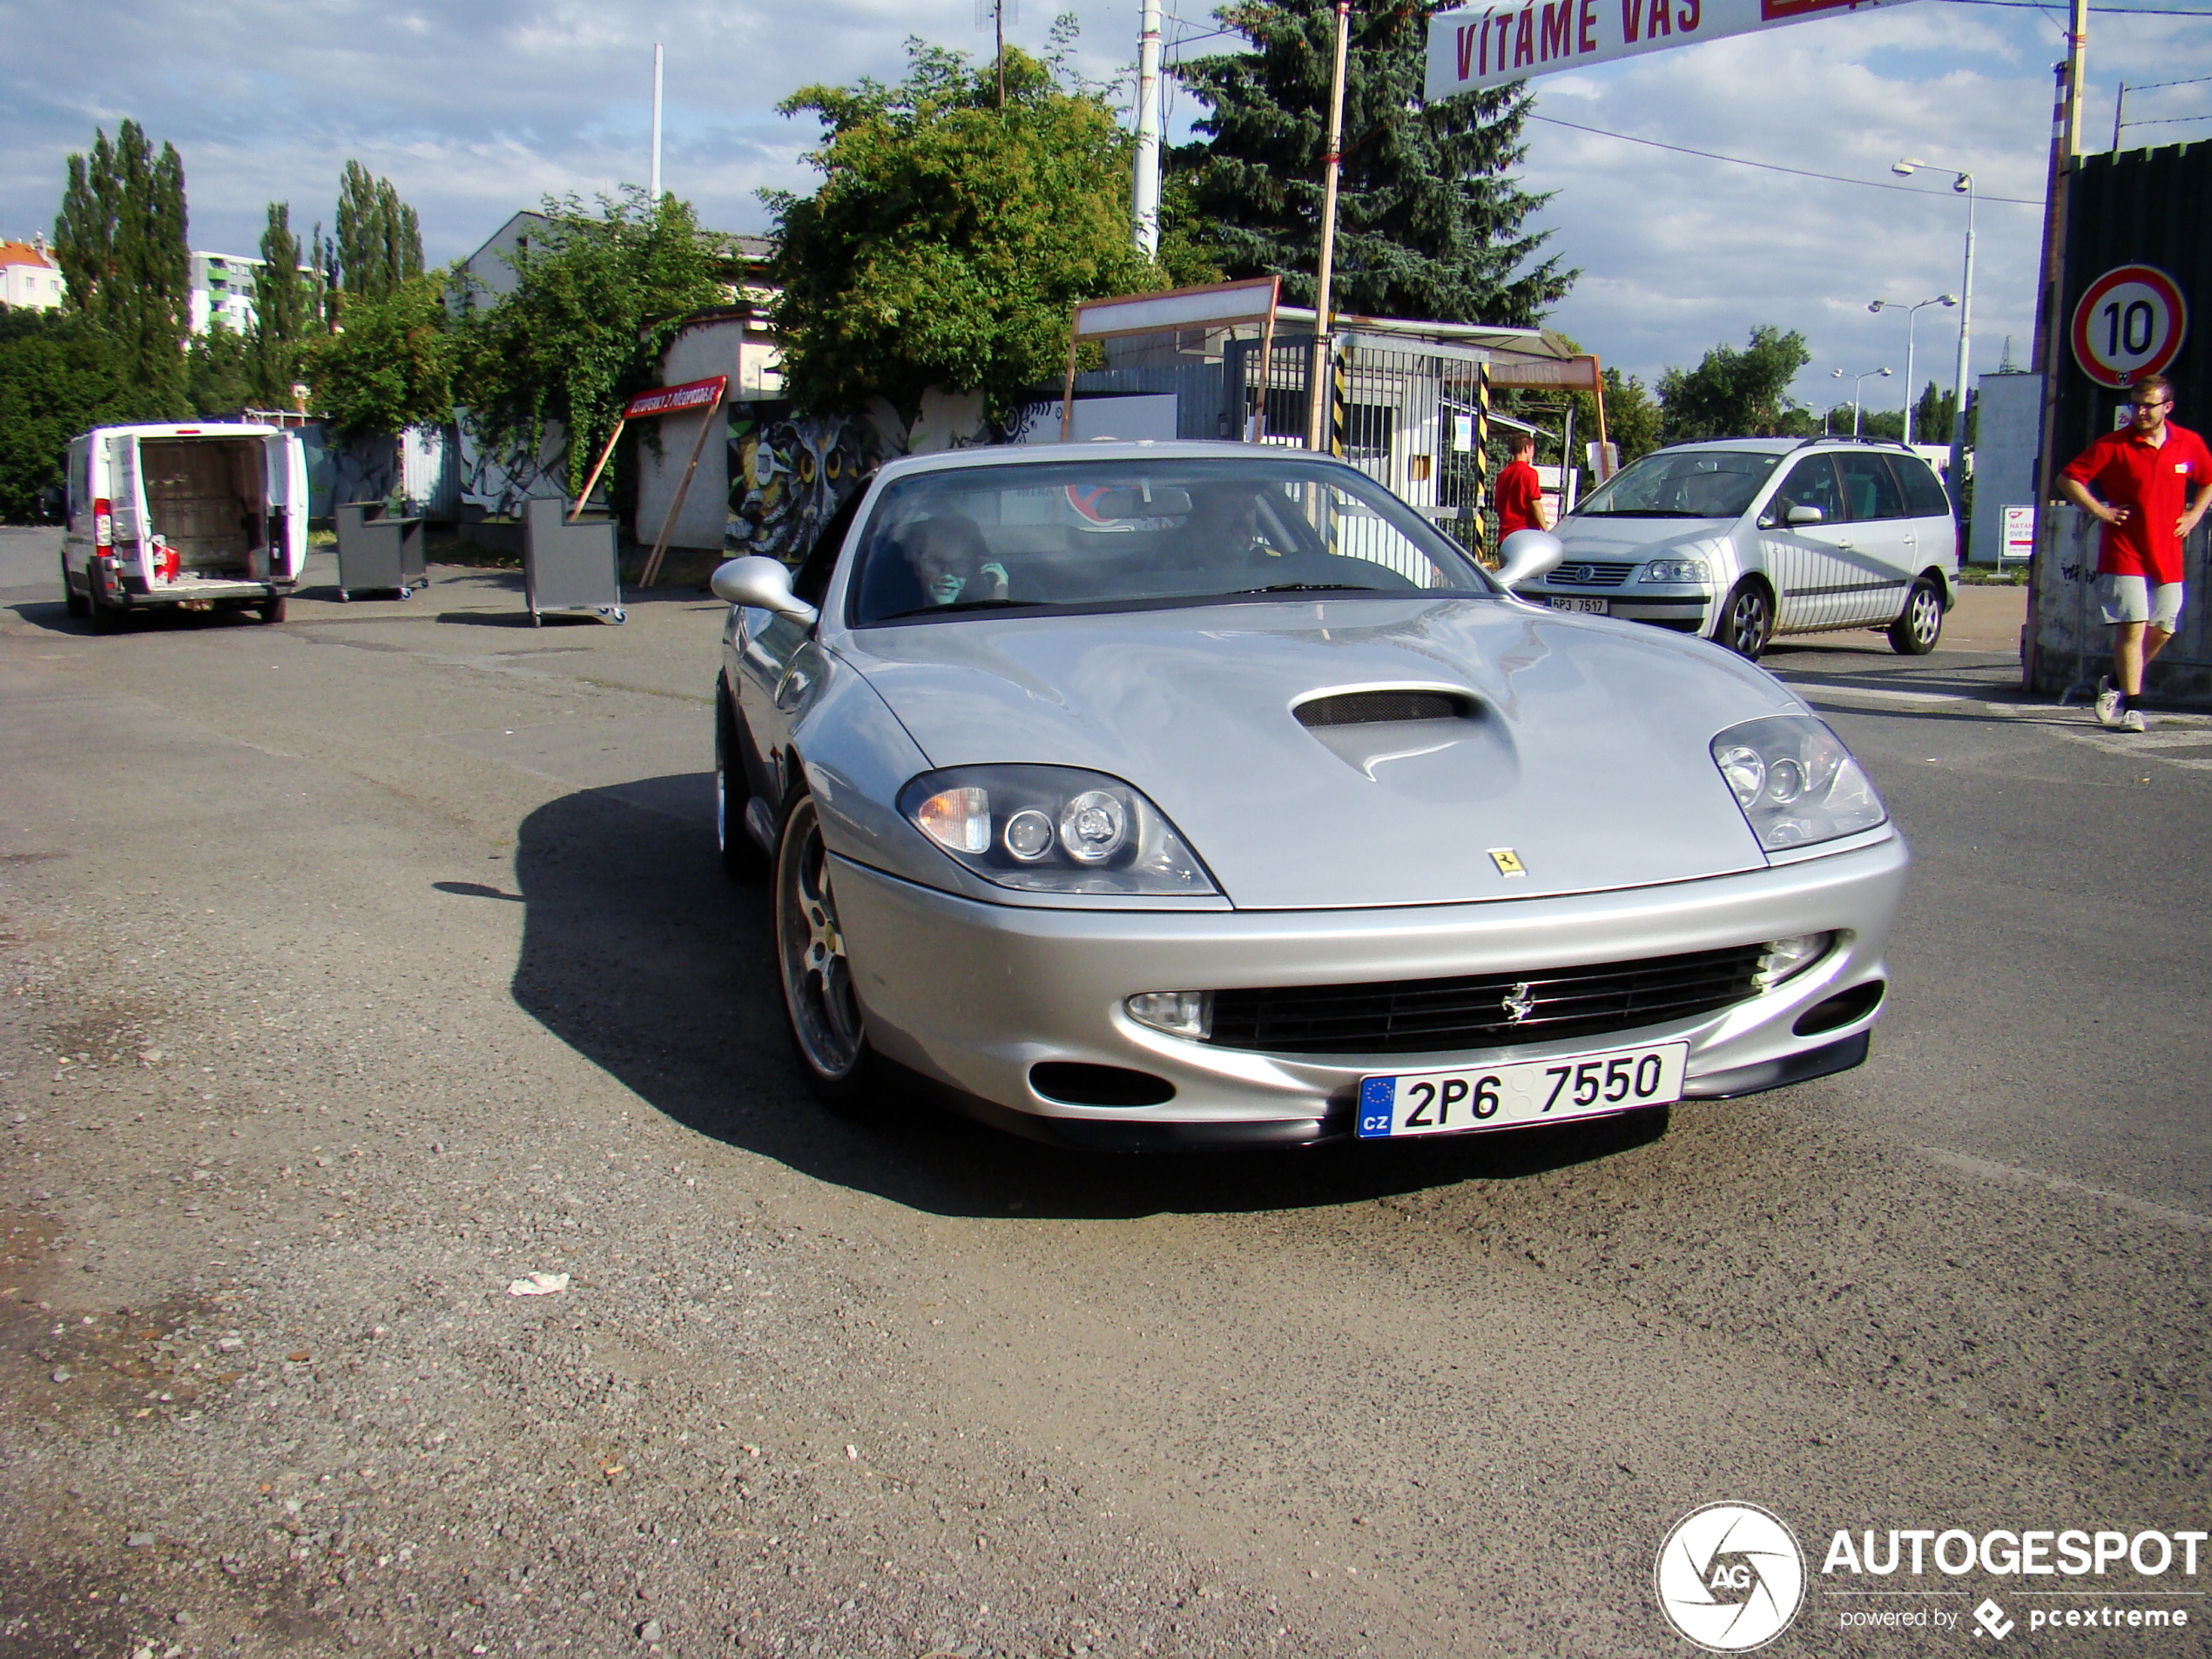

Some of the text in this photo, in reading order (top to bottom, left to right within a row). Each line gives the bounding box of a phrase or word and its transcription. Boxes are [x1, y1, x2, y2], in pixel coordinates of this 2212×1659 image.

[1456, 0, 1599, 82] VÍTÁME
[2104, 300, 2154, 357] 10
[1578, 599, 1603, 612] 7517
[1363, 1053, 1662, 1131] CZ 2P6 7550
